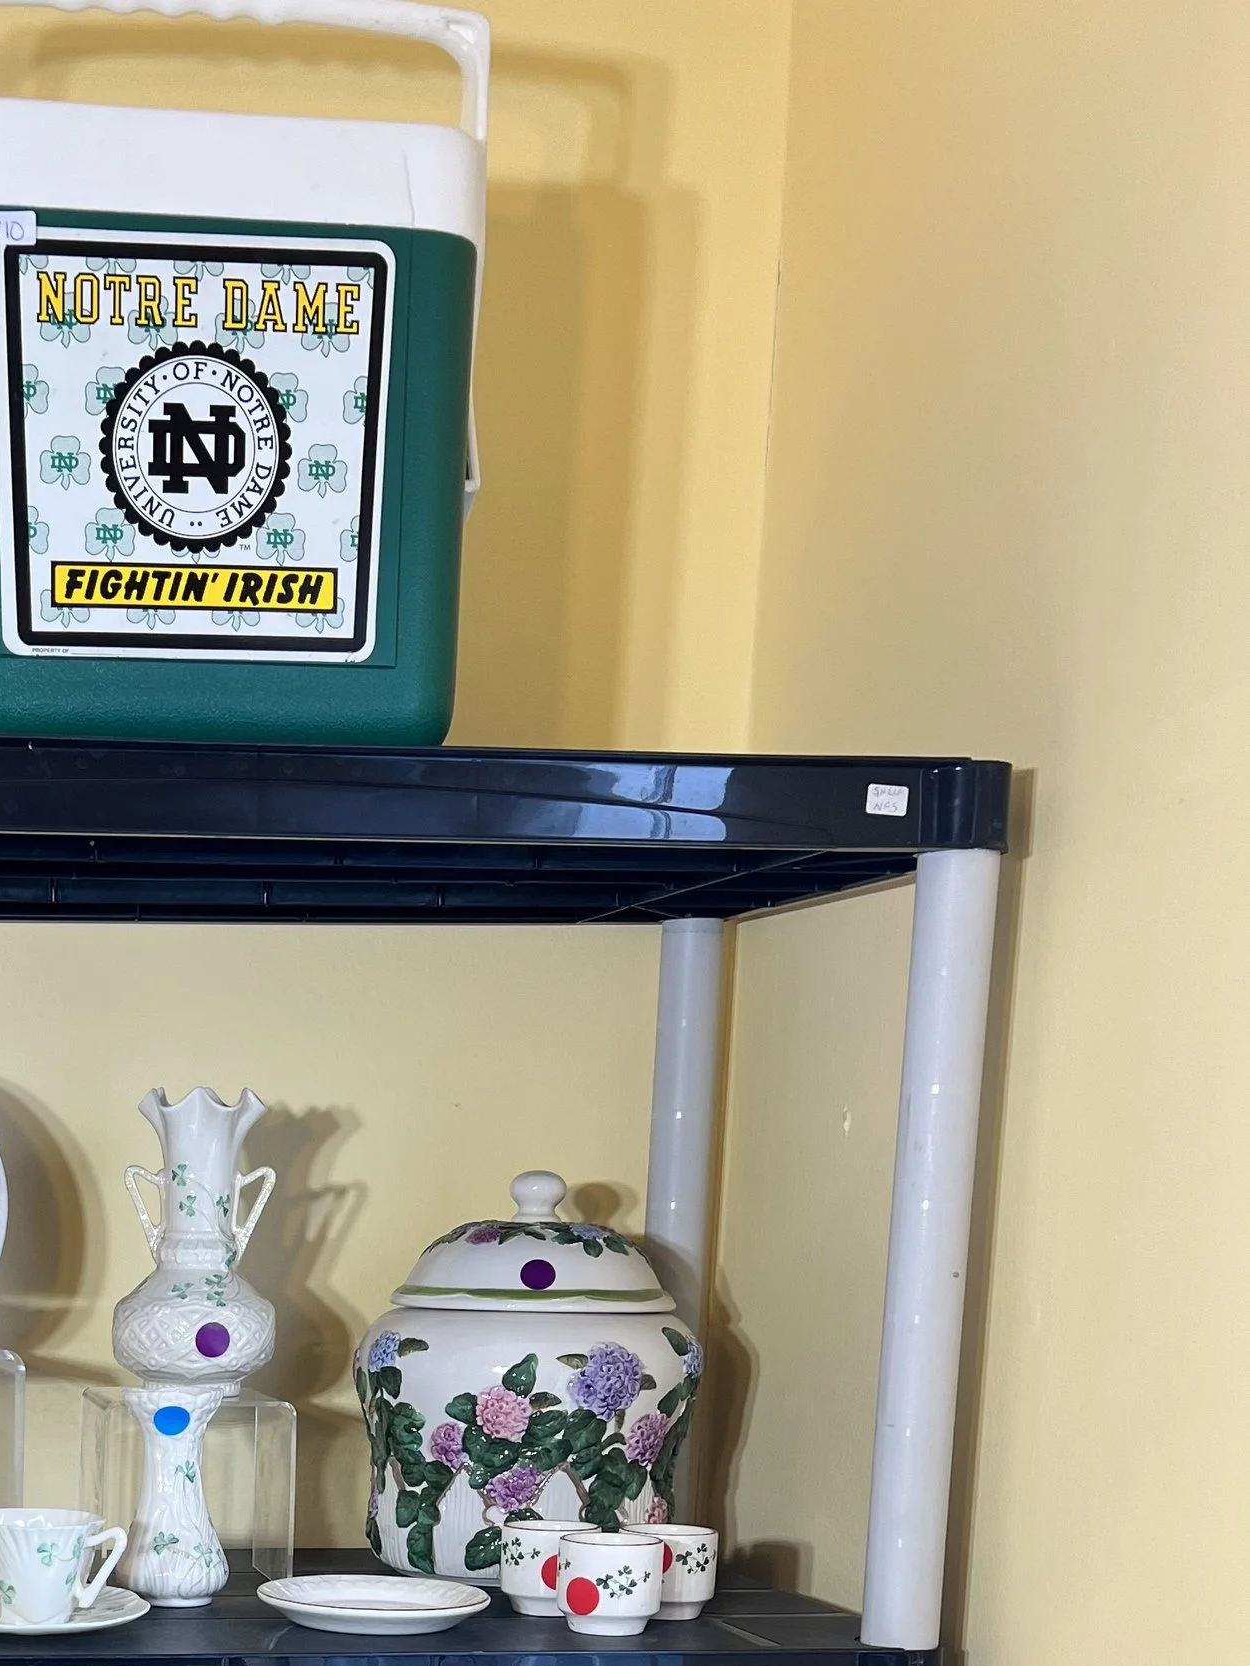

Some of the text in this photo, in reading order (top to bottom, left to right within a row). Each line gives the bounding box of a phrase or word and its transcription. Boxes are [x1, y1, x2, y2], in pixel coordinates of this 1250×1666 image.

[36, 271, 361, 335] NOTRE DAME
[118, 361, 274, 529] UNIVERSITY OF NOTRE DAME
[64, 568, 325, 606] FIGHTIN' IRISH
